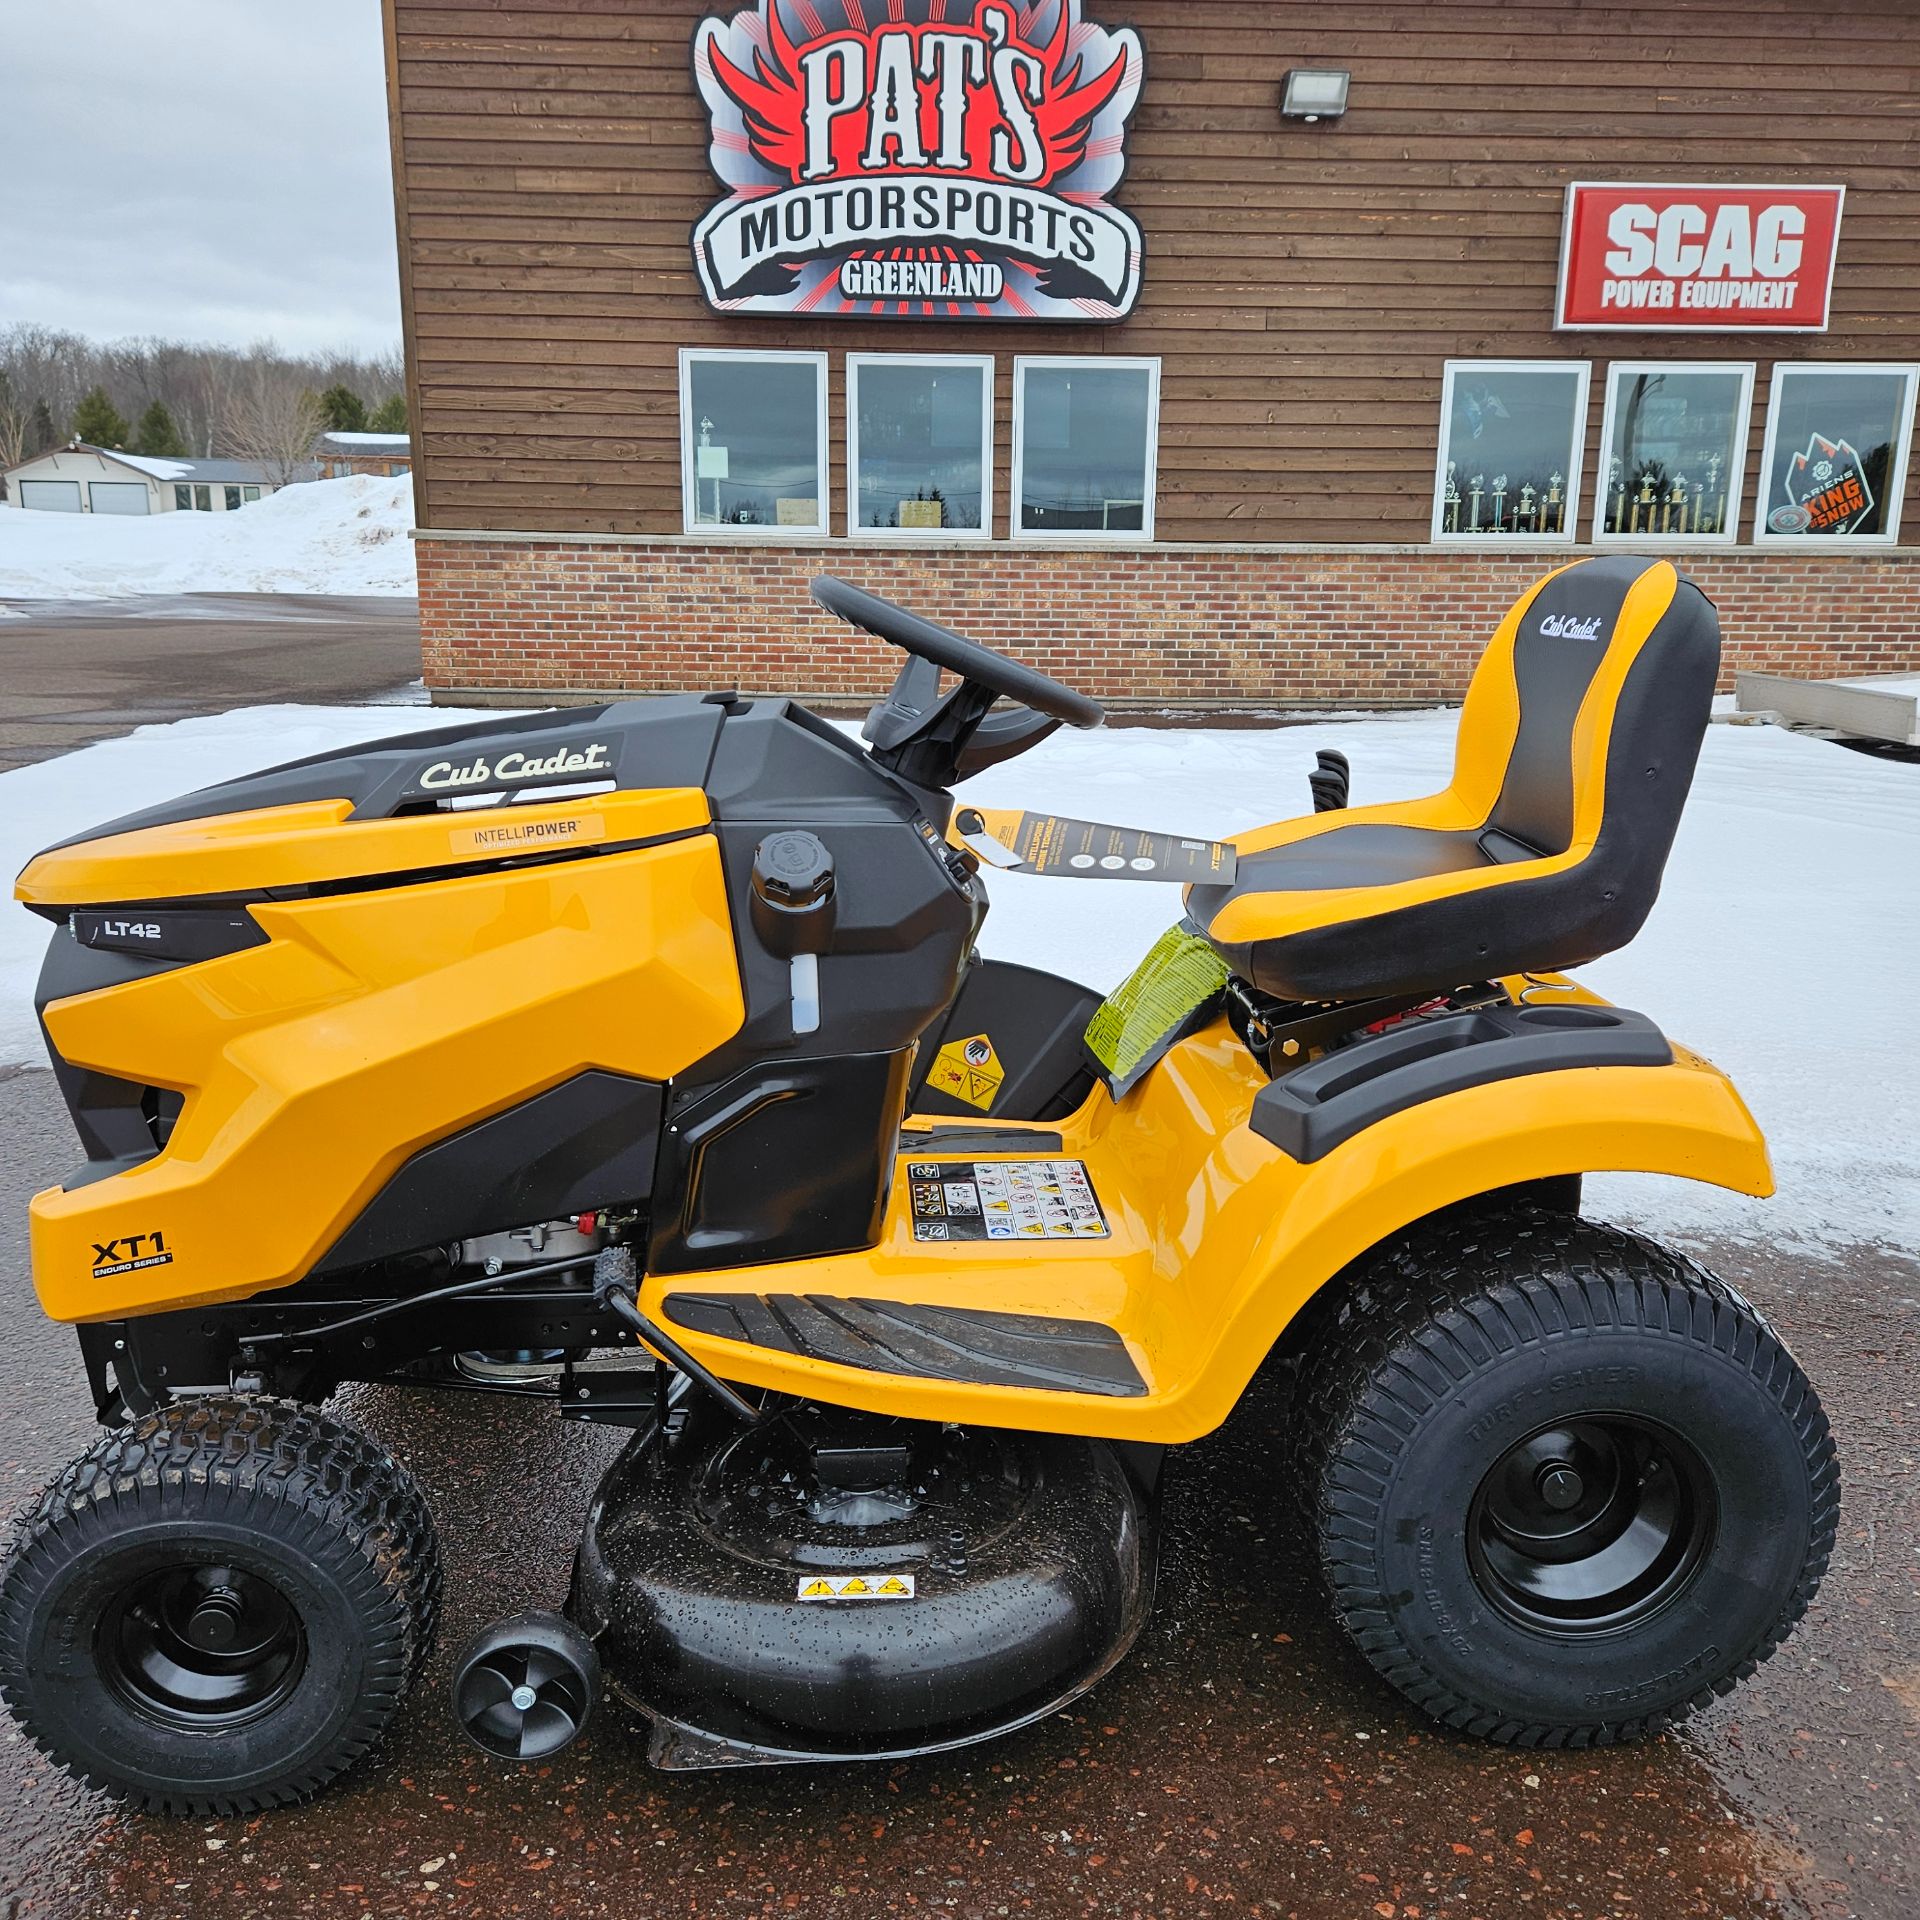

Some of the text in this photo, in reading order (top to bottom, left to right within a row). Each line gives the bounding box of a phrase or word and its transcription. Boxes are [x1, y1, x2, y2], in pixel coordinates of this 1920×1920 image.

[801, 9, 1046, 180] PAT'S
[741, 185, 1095, 263] MOTORSPORTS
[1604, 203, 1807, 278] SCAG
[841, 259, 1001, 298] GREENLAND
[1601, 279, 1799, 309] POWER EQUIPMENT
[1801, 469, 1854, 502] ARIENS
[1803, 477, 1860, 516] KING
[1817, 494, 1865, 528] SNOW
[1540, 614, 1602, 640] Cub Cadet
[420, 757, 490, 788] Cub
[483, 838, 520, 849] OPTIMIZED
[104, 921, 161, 939] LT42
[91, 1231, 164, 1266] XT1
[94, 1255, 167, 1277] ENDURO SERIES
